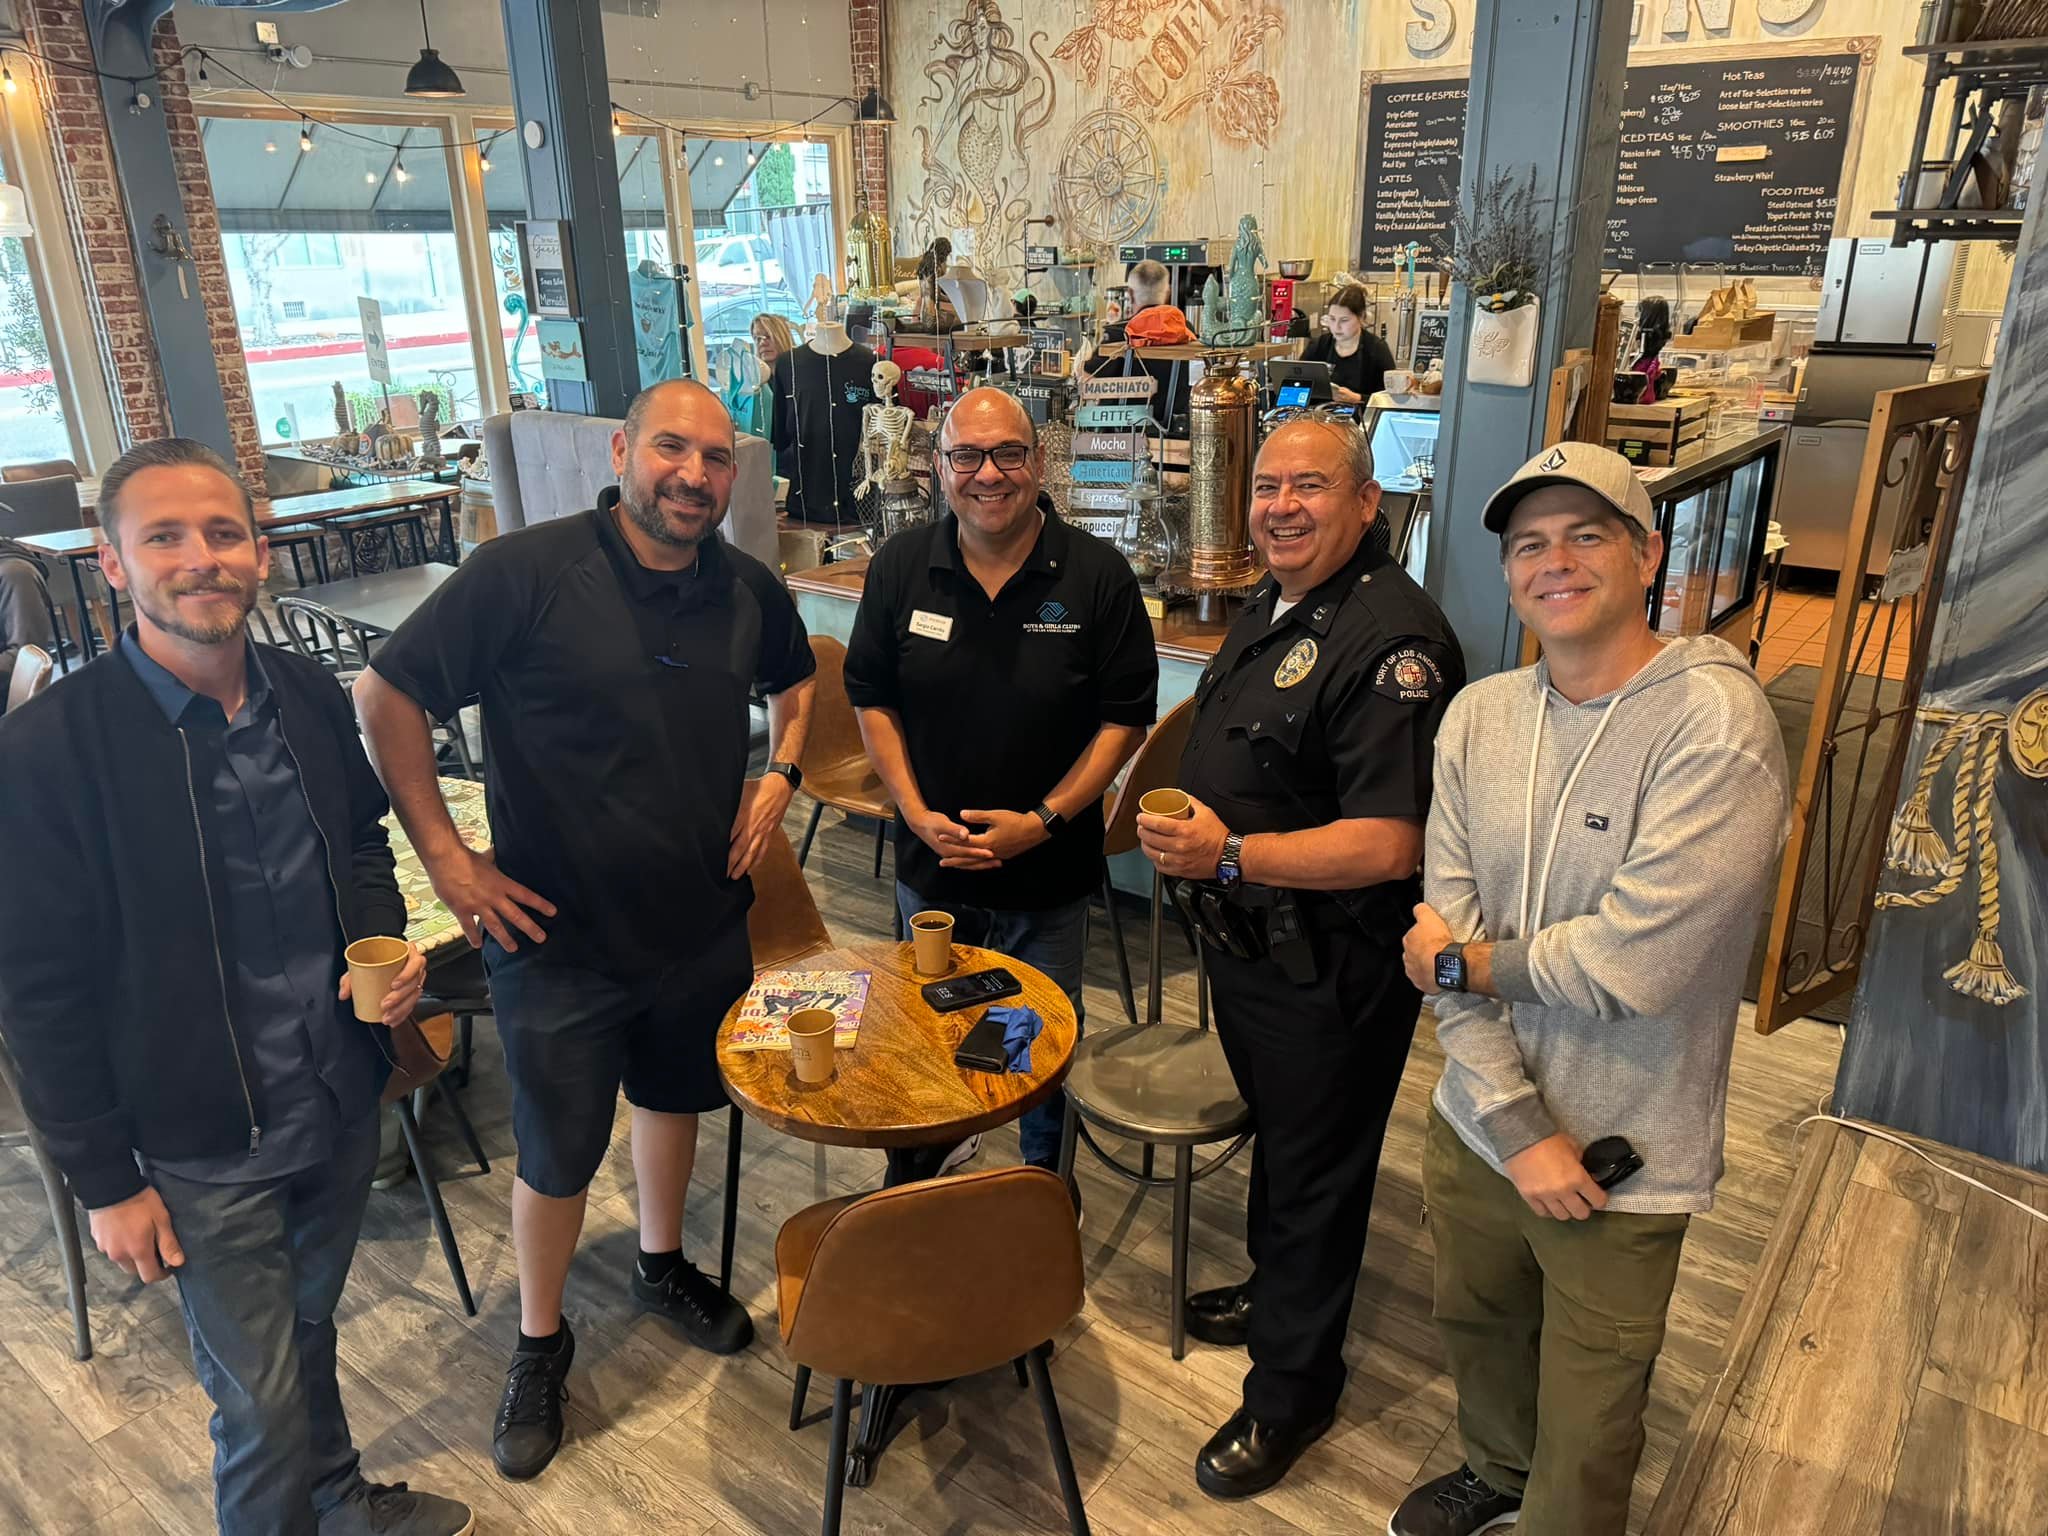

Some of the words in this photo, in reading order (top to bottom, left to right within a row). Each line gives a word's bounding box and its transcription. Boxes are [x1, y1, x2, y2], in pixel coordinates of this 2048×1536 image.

[1722, 71, 1742, 81] Hot
[1743, 70, 1765, 80] Teas
[1387, 93, 1424, 103] COFFEE
[1717, 119, 1784, 132] SMOOTHIES
[1621, 133, 1646, 143] ICED
[1647, 132, 1674, 142] TEAS
[1620, 149, 1645, 158] Passion
[1620, 161, 1637, 170] Black
[1379, 174, 1412, 184] LATTES
[1618, 173, 1634, 181] Mint
[1714, 171, 1754, 182] Strawberry
[1755, 171, 1774, 180] Whirl
[1617, 185, 1645, 193] Hibiscus
[1761, 187, 1793, 197] FOOD
[1793, 187, 1825, 196] ITEMS
[1638, 195, 1658, 204] Green
[1085, 381, 1149, 394] MACCHIATO
[1092, 410, 1133, 422] LATTE
[1091, 436, 1126, 450] Mocha
[1376, 663, 1389, 686] PORT
[1386, 654, 1398, 665] OF
[1398, 649, 1415, 658] LOS
[1399, 690, 1430, 699] POLICE
